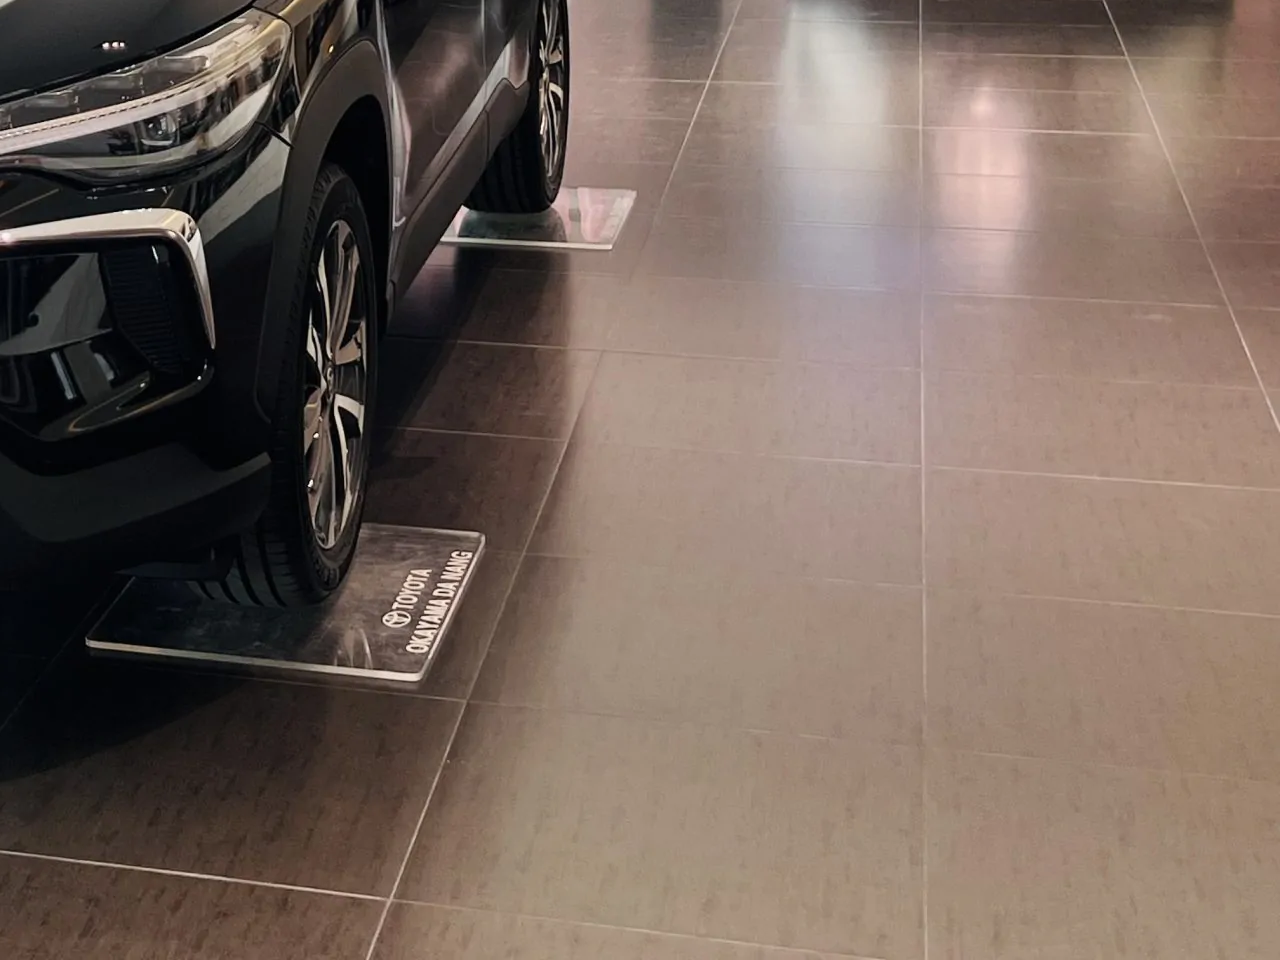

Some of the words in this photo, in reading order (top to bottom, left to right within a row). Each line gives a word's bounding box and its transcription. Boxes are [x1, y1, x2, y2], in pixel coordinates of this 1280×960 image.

[440, 550, 474, 581] NANG
[391, 568, 433, 610] TOYOTA
[432, 581, 460, 598] DA
[405, 599, 452, 654] OKAYAMA
